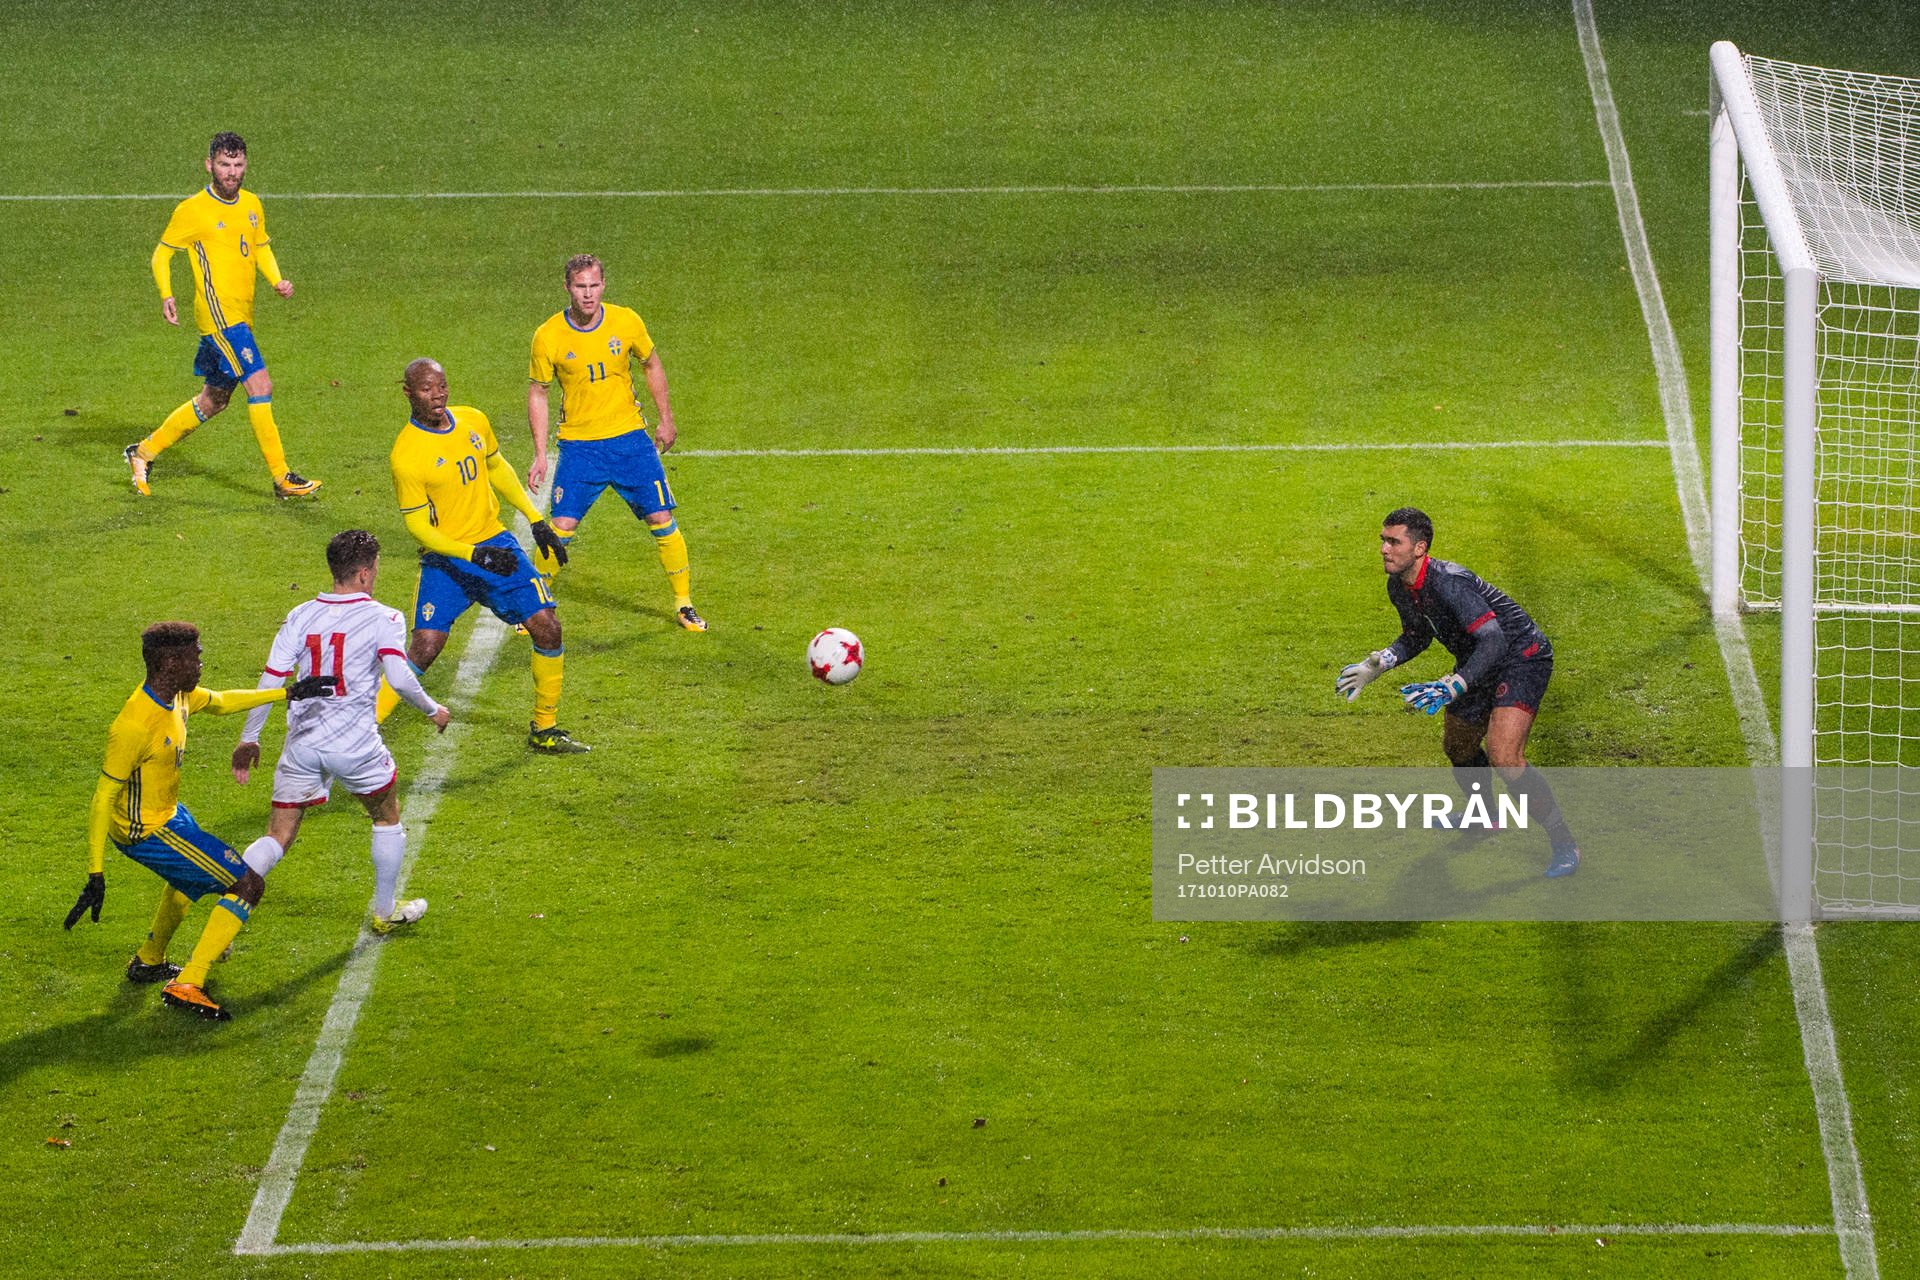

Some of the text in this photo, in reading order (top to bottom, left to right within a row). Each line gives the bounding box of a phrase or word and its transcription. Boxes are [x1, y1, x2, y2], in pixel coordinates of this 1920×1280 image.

[240, 233, 249, 257] 6
[587, 361, 605, 383] 11
[456, 455, 477, 485] 10
[305, 632, 347, 696] 11
